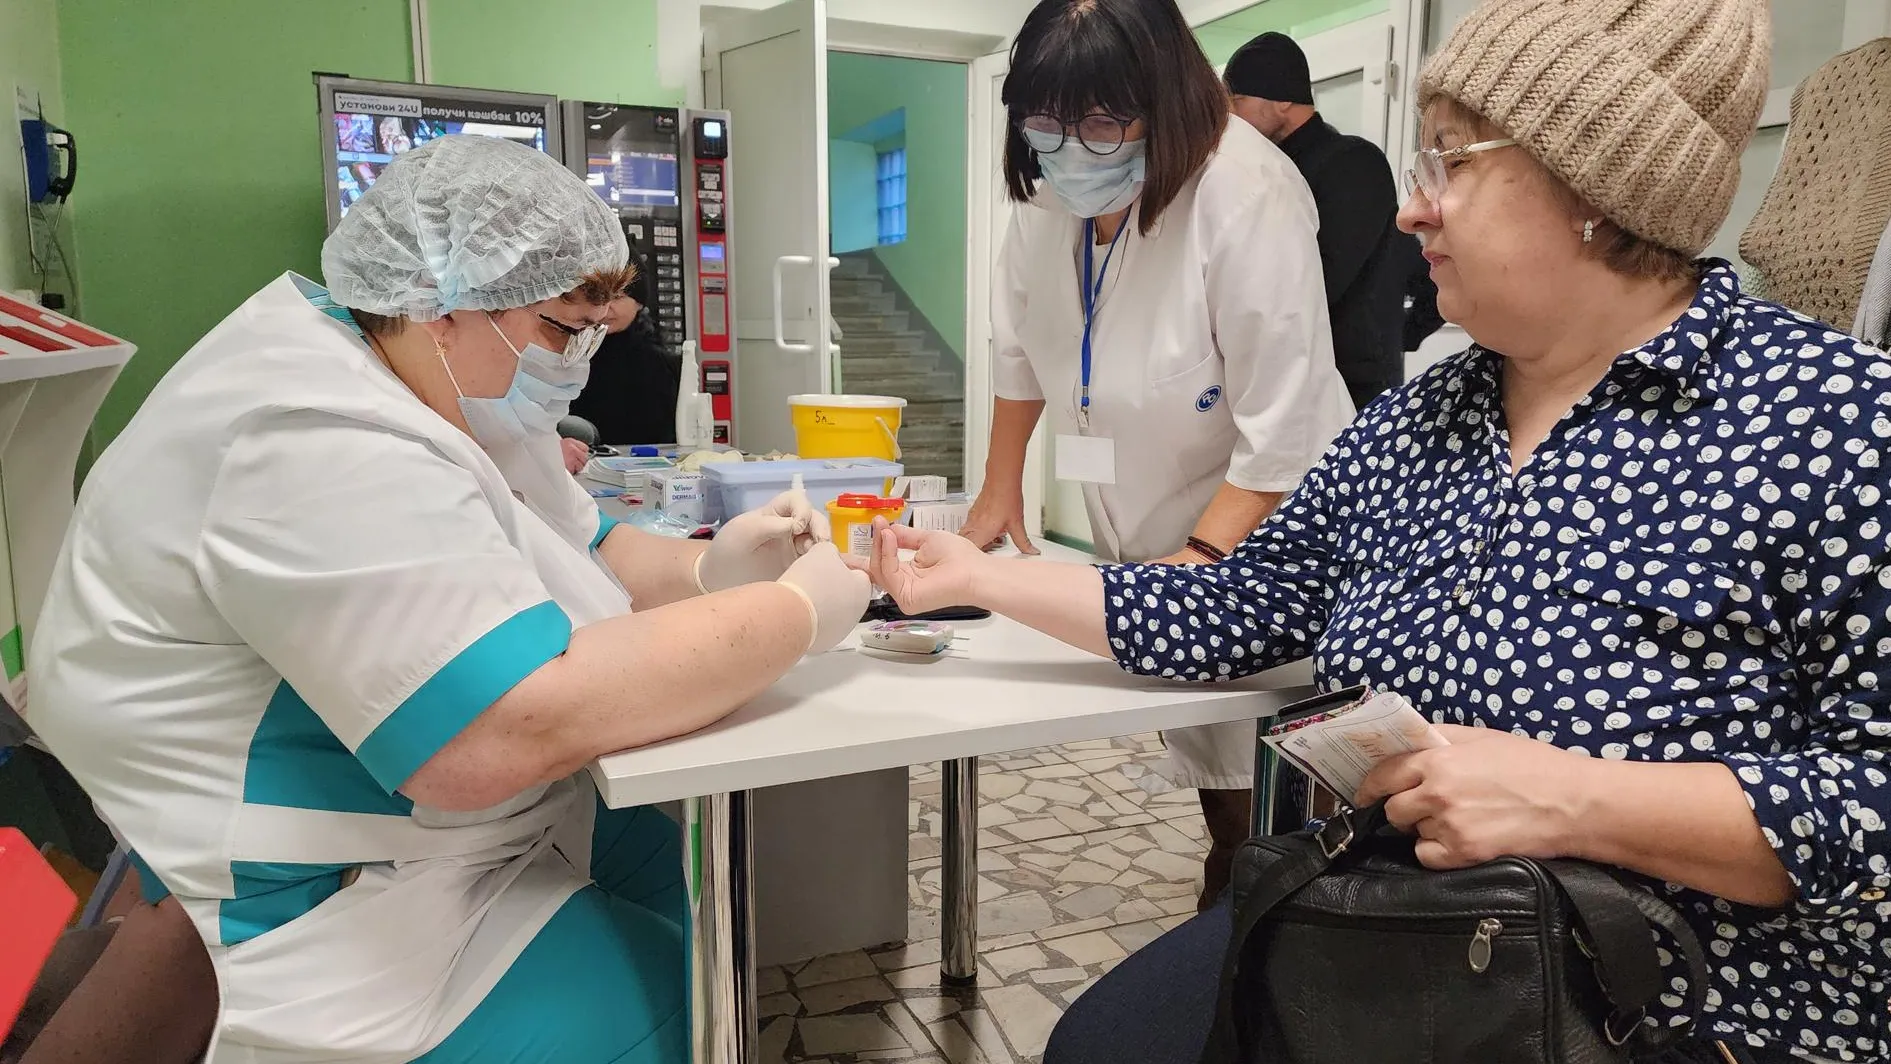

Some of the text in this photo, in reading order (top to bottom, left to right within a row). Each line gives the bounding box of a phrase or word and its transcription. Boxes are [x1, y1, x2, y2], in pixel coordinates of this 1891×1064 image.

[340, 101, 395, 112] установи
[423, 107, 465, 118] получи
[467, 110, 511, 121] кэшбэк
[515, 111, 544, 125] 10%
